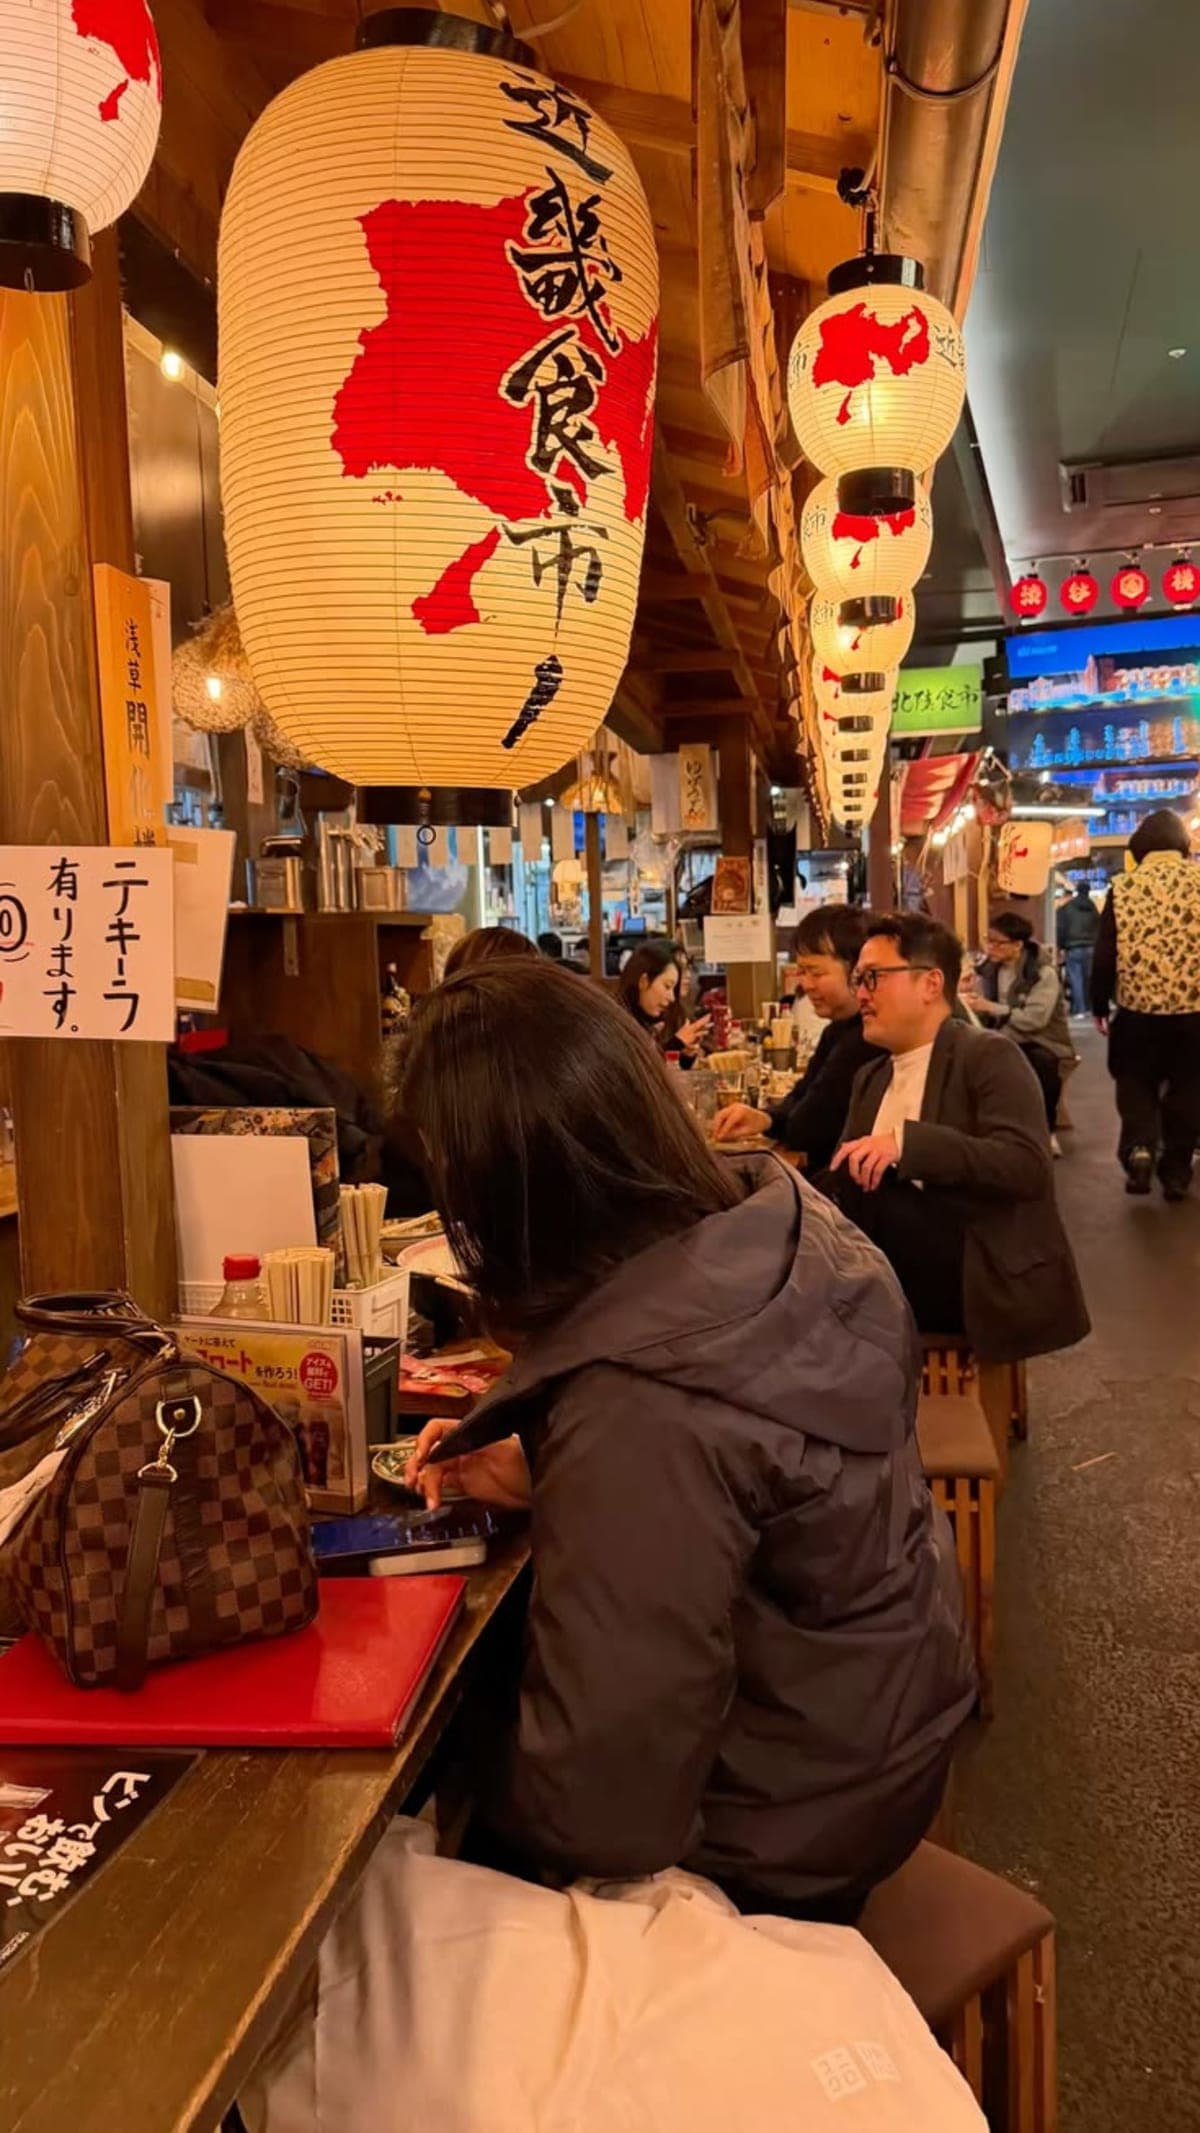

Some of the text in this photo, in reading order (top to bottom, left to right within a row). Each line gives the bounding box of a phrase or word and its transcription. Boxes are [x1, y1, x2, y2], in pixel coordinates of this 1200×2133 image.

[42, 857, 81, 1032] 有ります。
[102, 861, 149, 1032] テキーラ
